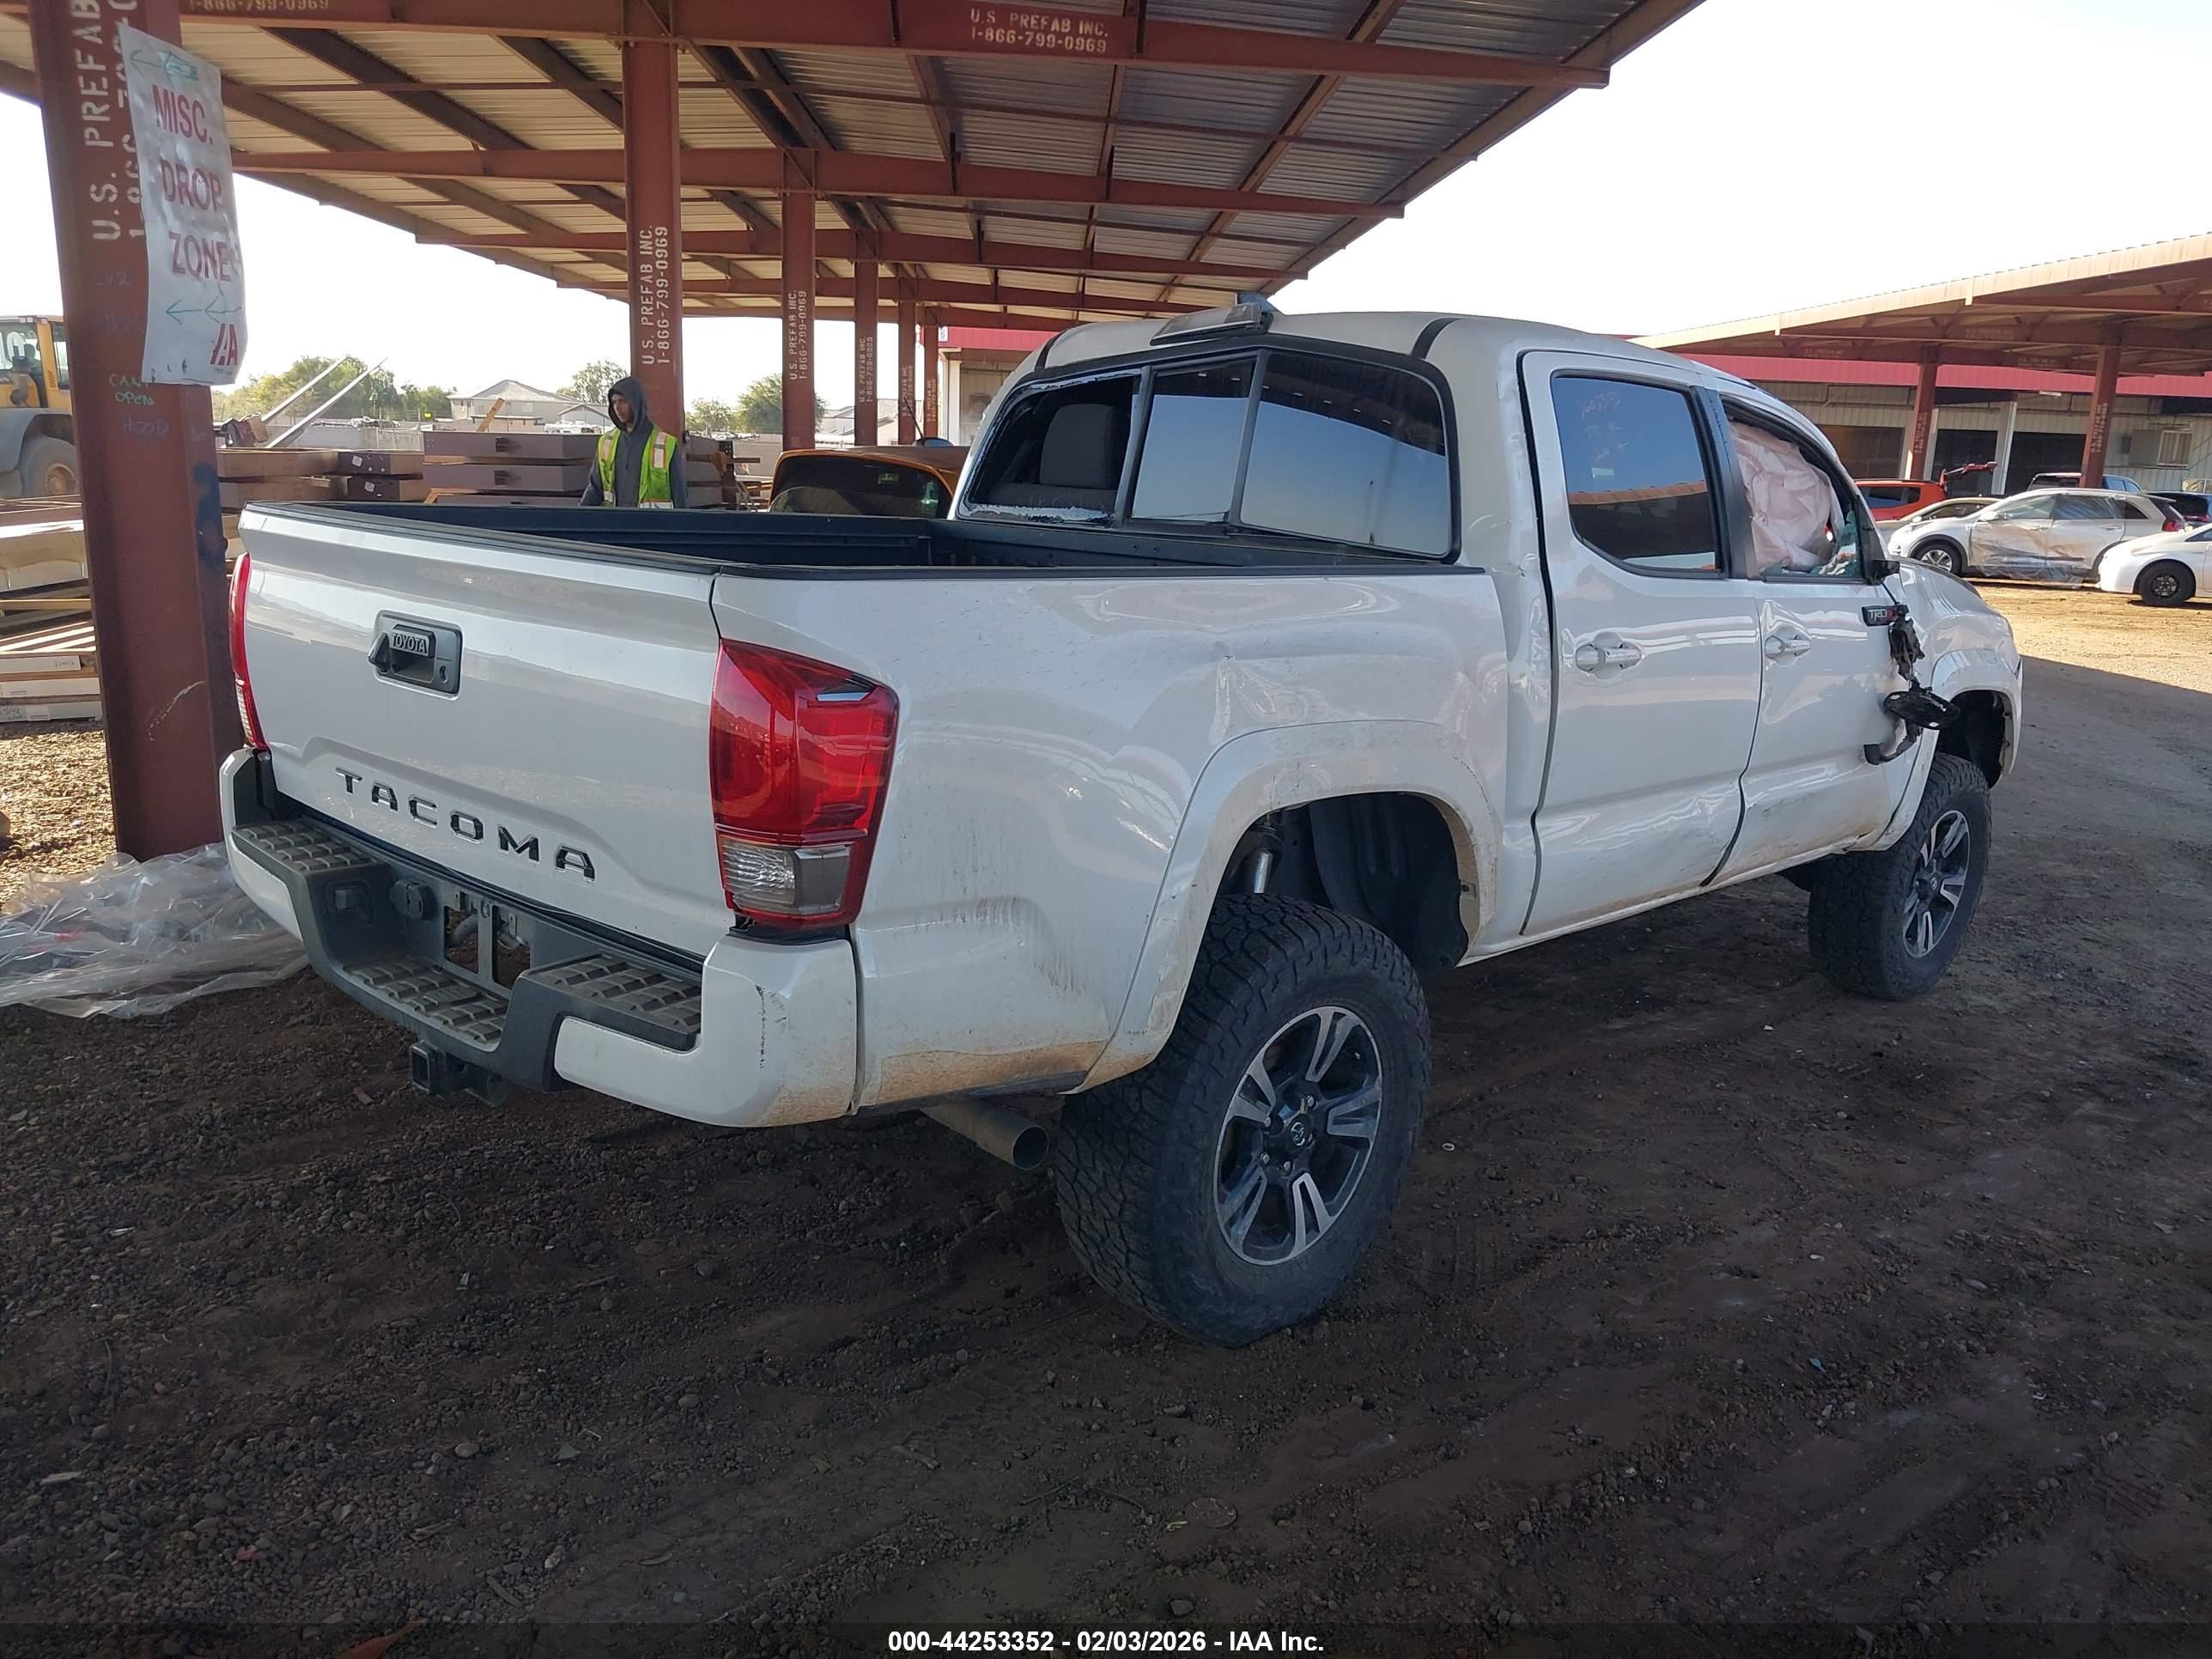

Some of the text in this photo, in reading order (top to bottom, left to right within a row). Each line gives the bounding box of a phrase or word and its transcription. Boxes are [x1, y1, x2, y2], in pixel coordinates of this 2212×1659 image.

[971, 27, 1107, 53] 1-866-799-0969
[1010, 12, 1072, 33] PREFAB
[1079, 20, 1109, 37] INC.
[70, 0, 113, 147] PREFAB
[152, 85, 214, 145] MISC.
[90, 173, 121, 240] U.S.
[161, 159, 222, 212] DROP
[169, 231, 231, 282] ZONE
[640, 225, 655, 365] U.S. PREFAB INC.
[655, 226, 671, 364] 1-866-799-0969
[788, 314, 798, 355] PREFAB
[789, 360, 798, 380] U.S.
[392, 632, 428, 653] TOYOTA
[336, 767, 596, 883] TACOMA
